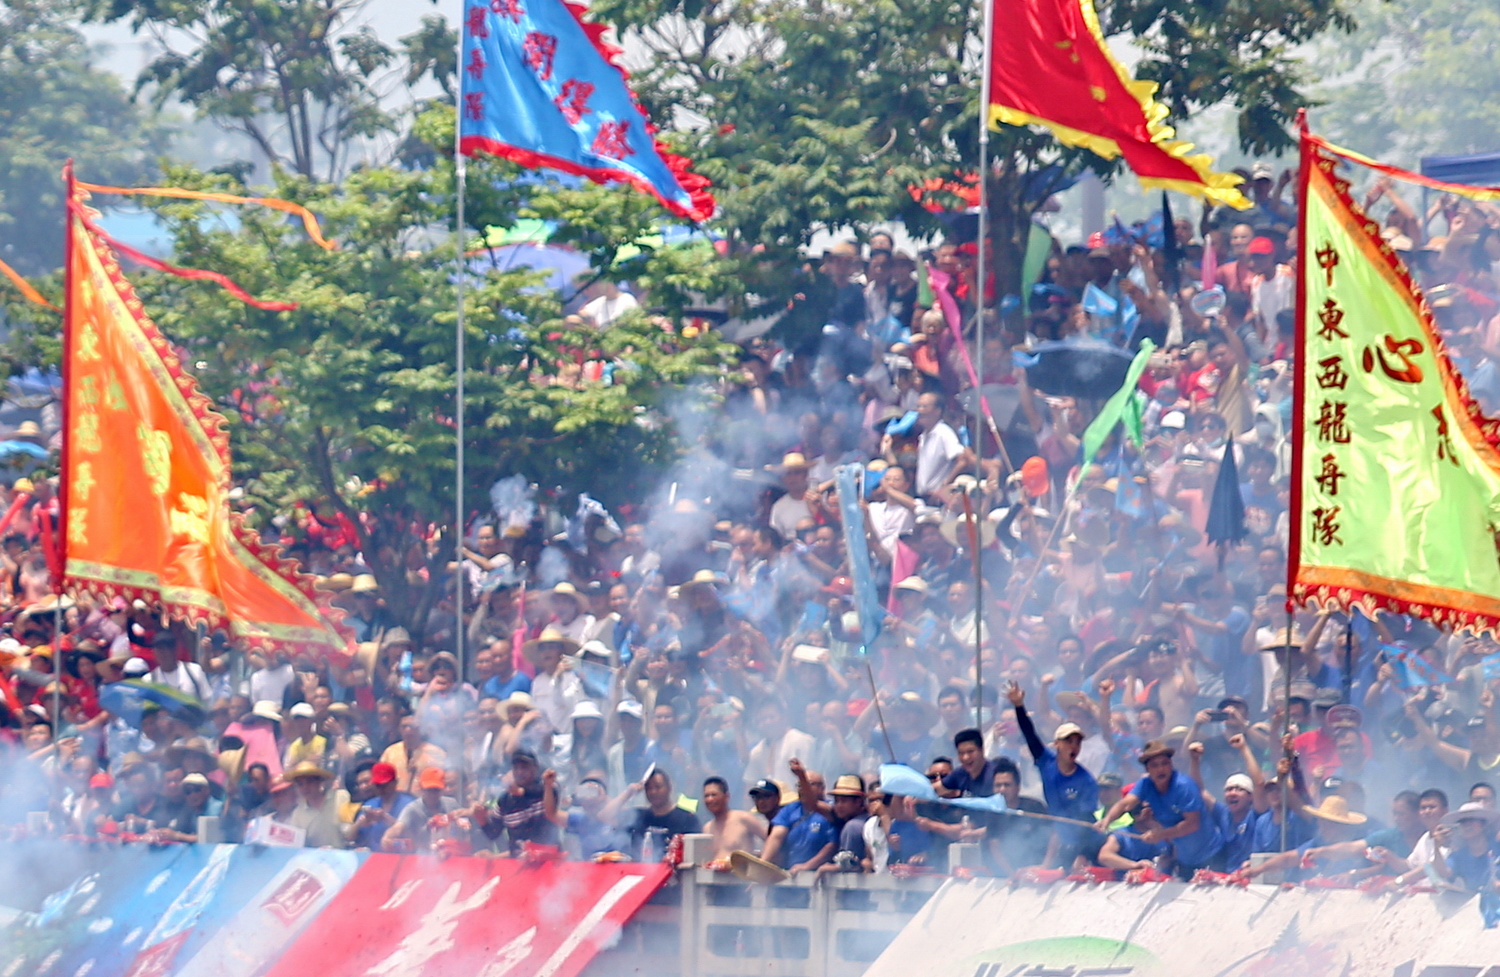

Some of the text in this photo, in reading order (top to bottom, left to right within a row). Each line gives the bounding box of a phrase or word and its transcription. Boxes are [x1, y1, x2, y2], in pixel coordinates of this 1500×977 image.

[1312, 241, 1351, 547] 中東西龍舟隊
